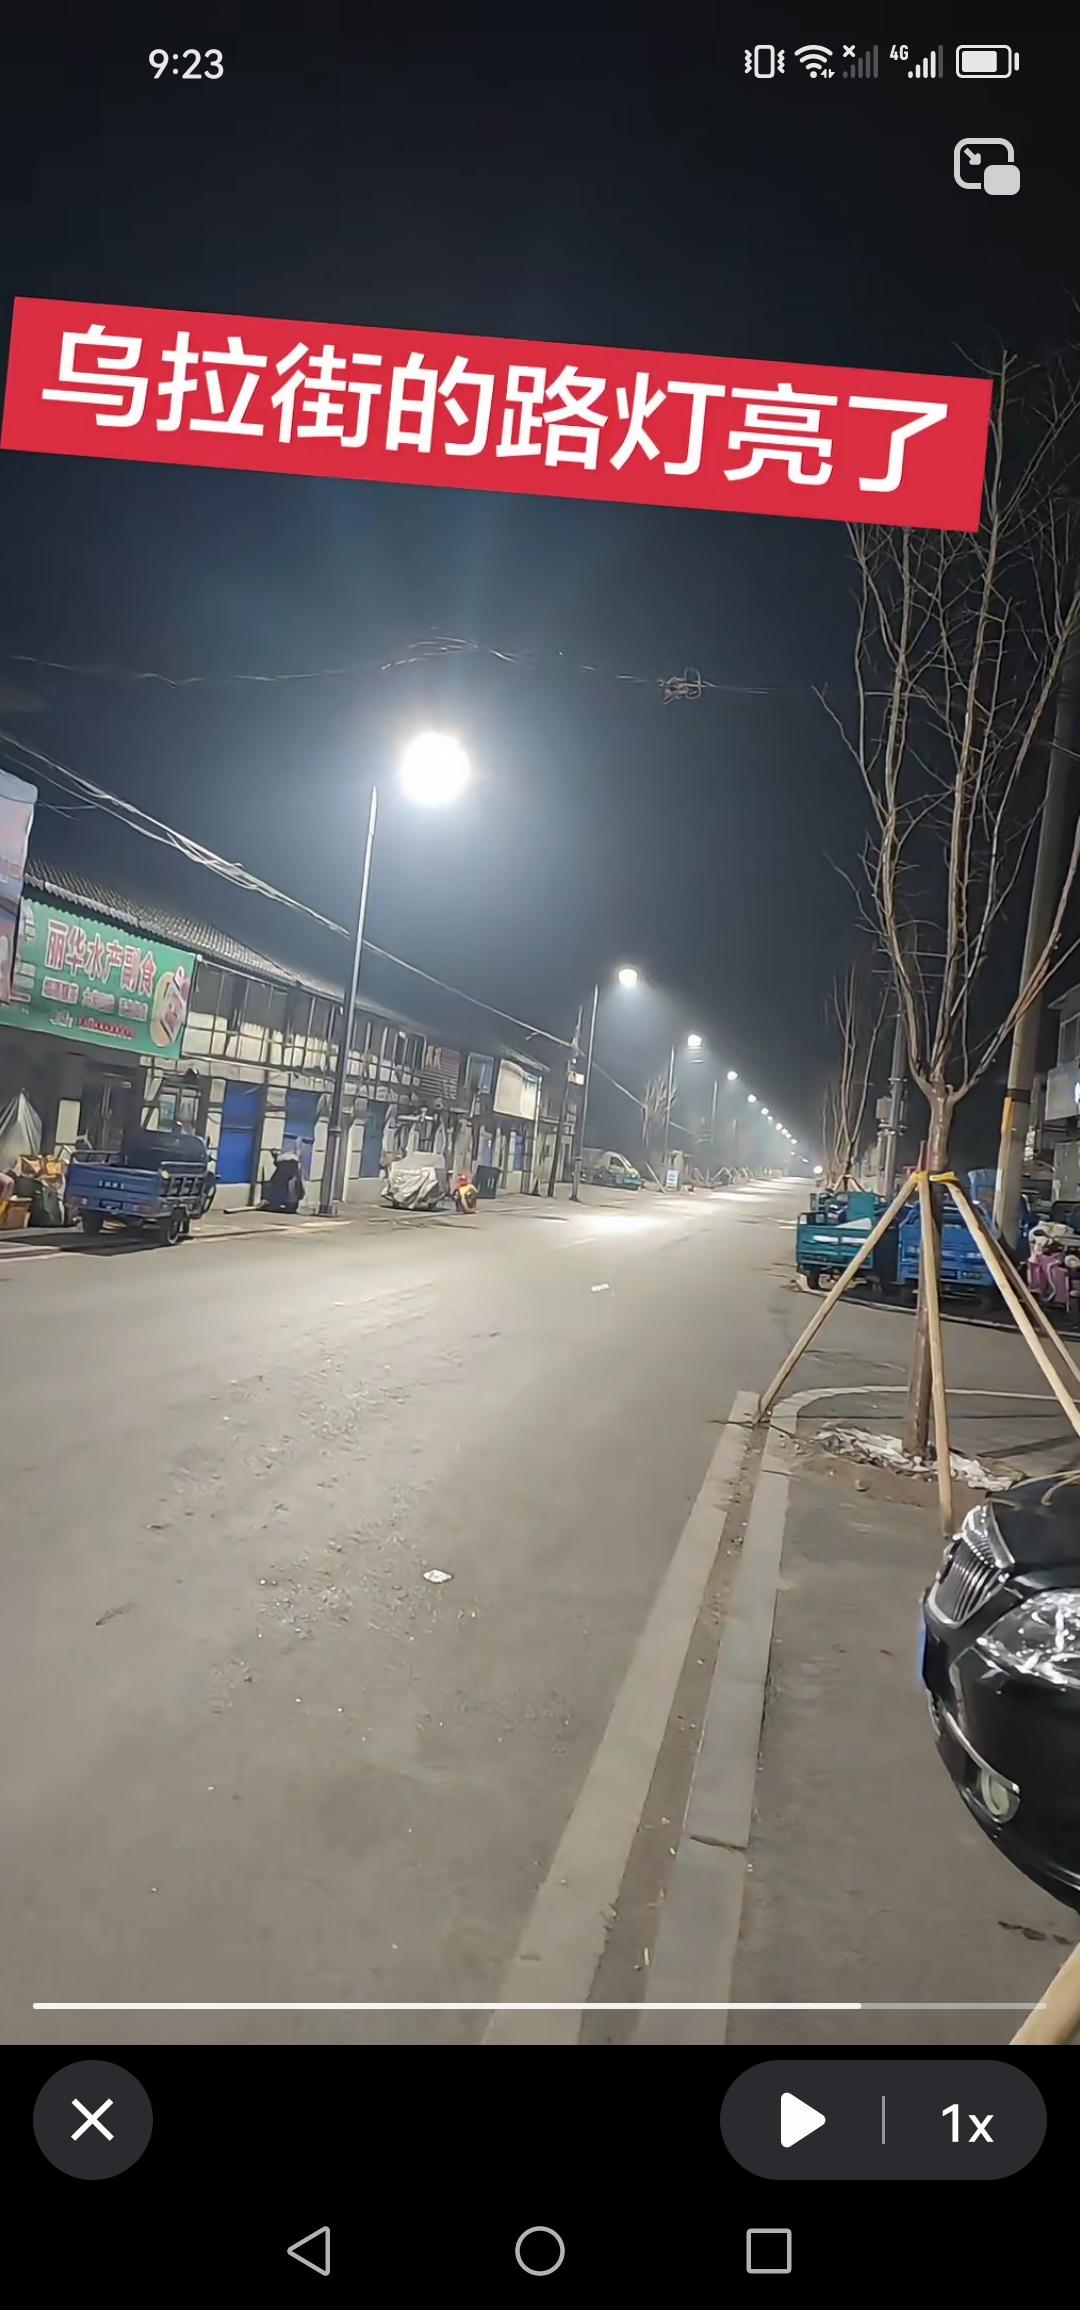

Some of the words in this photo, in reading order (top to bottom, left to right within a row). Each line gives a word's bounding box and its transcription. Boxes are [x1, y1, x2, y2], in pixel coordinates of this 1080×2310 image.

[44, 919, 157, 998] 丽华水产副食
